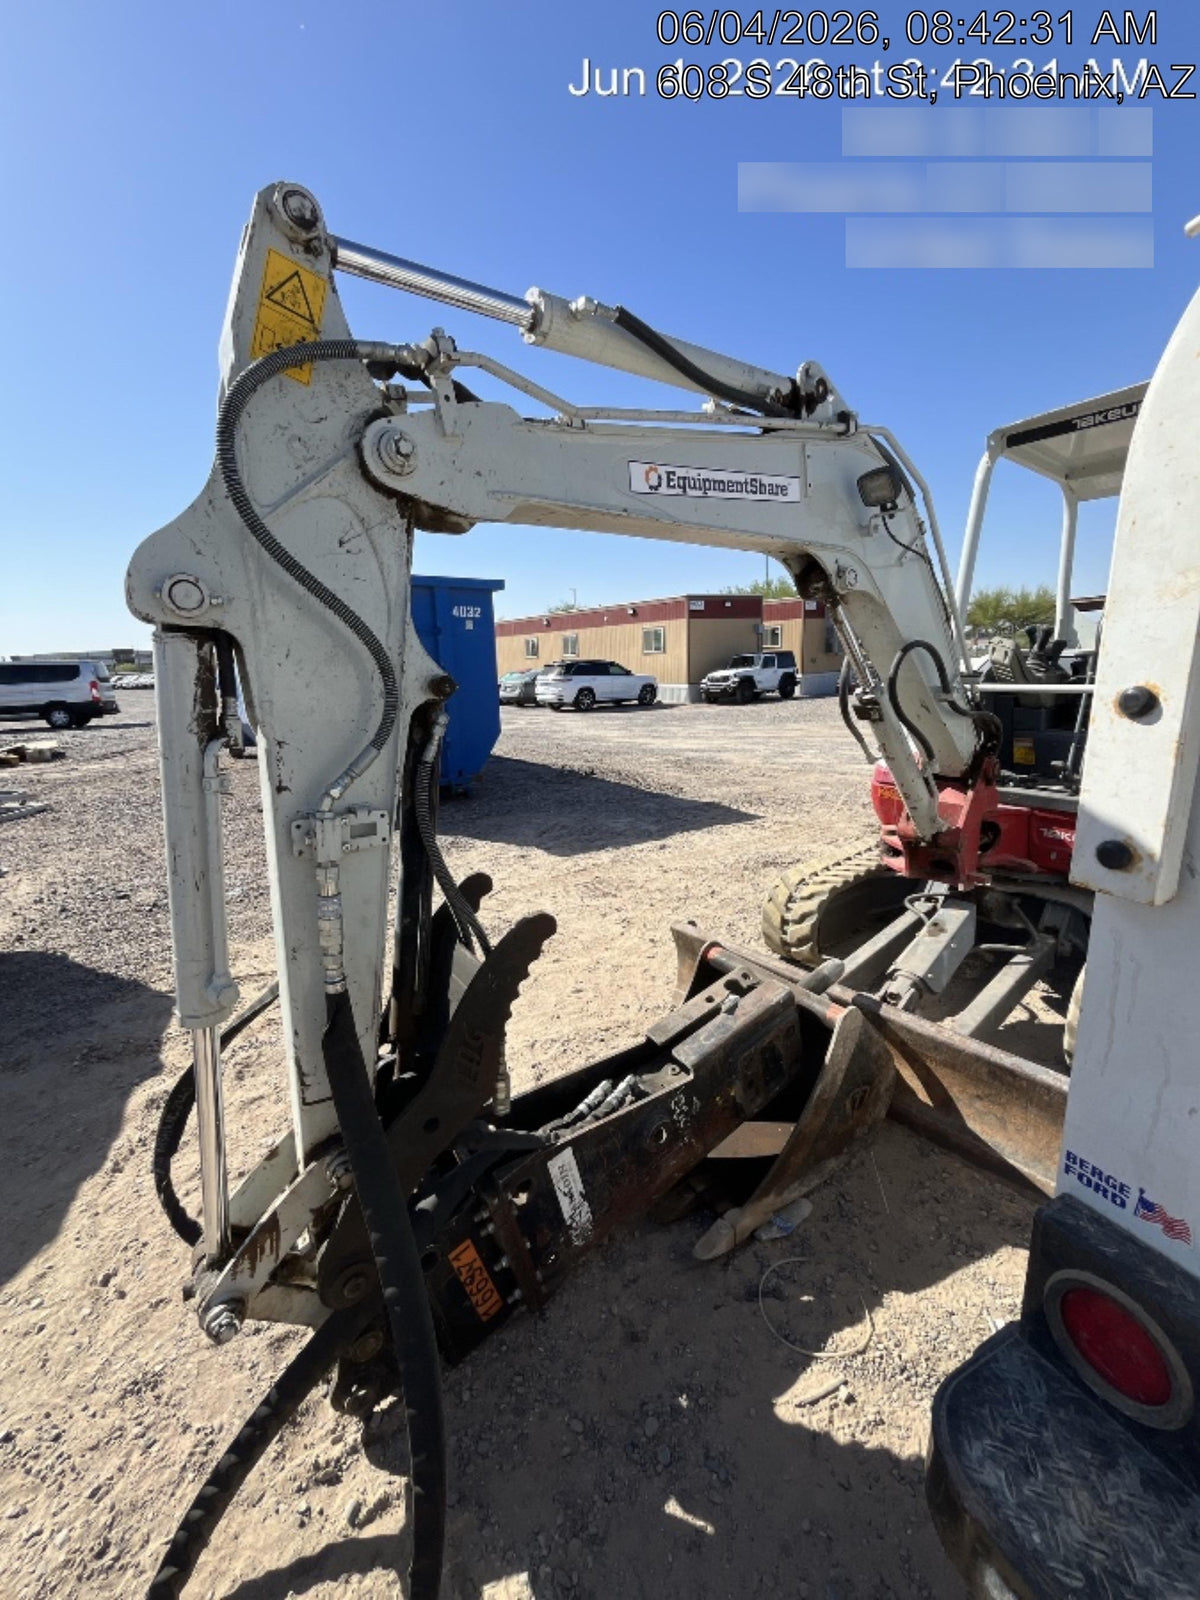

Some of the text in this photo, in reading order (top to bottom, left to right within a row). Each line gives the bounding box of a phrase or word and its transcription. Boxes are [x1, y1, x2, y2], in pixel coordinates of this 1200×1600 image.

[666, 471, 789, 496] EquipmentShare
[452, 605, 481, 618] 4032
[1064, 1162, 1127, 1210] FORD
[1065, 1150, 1131, 1199] BERGE
